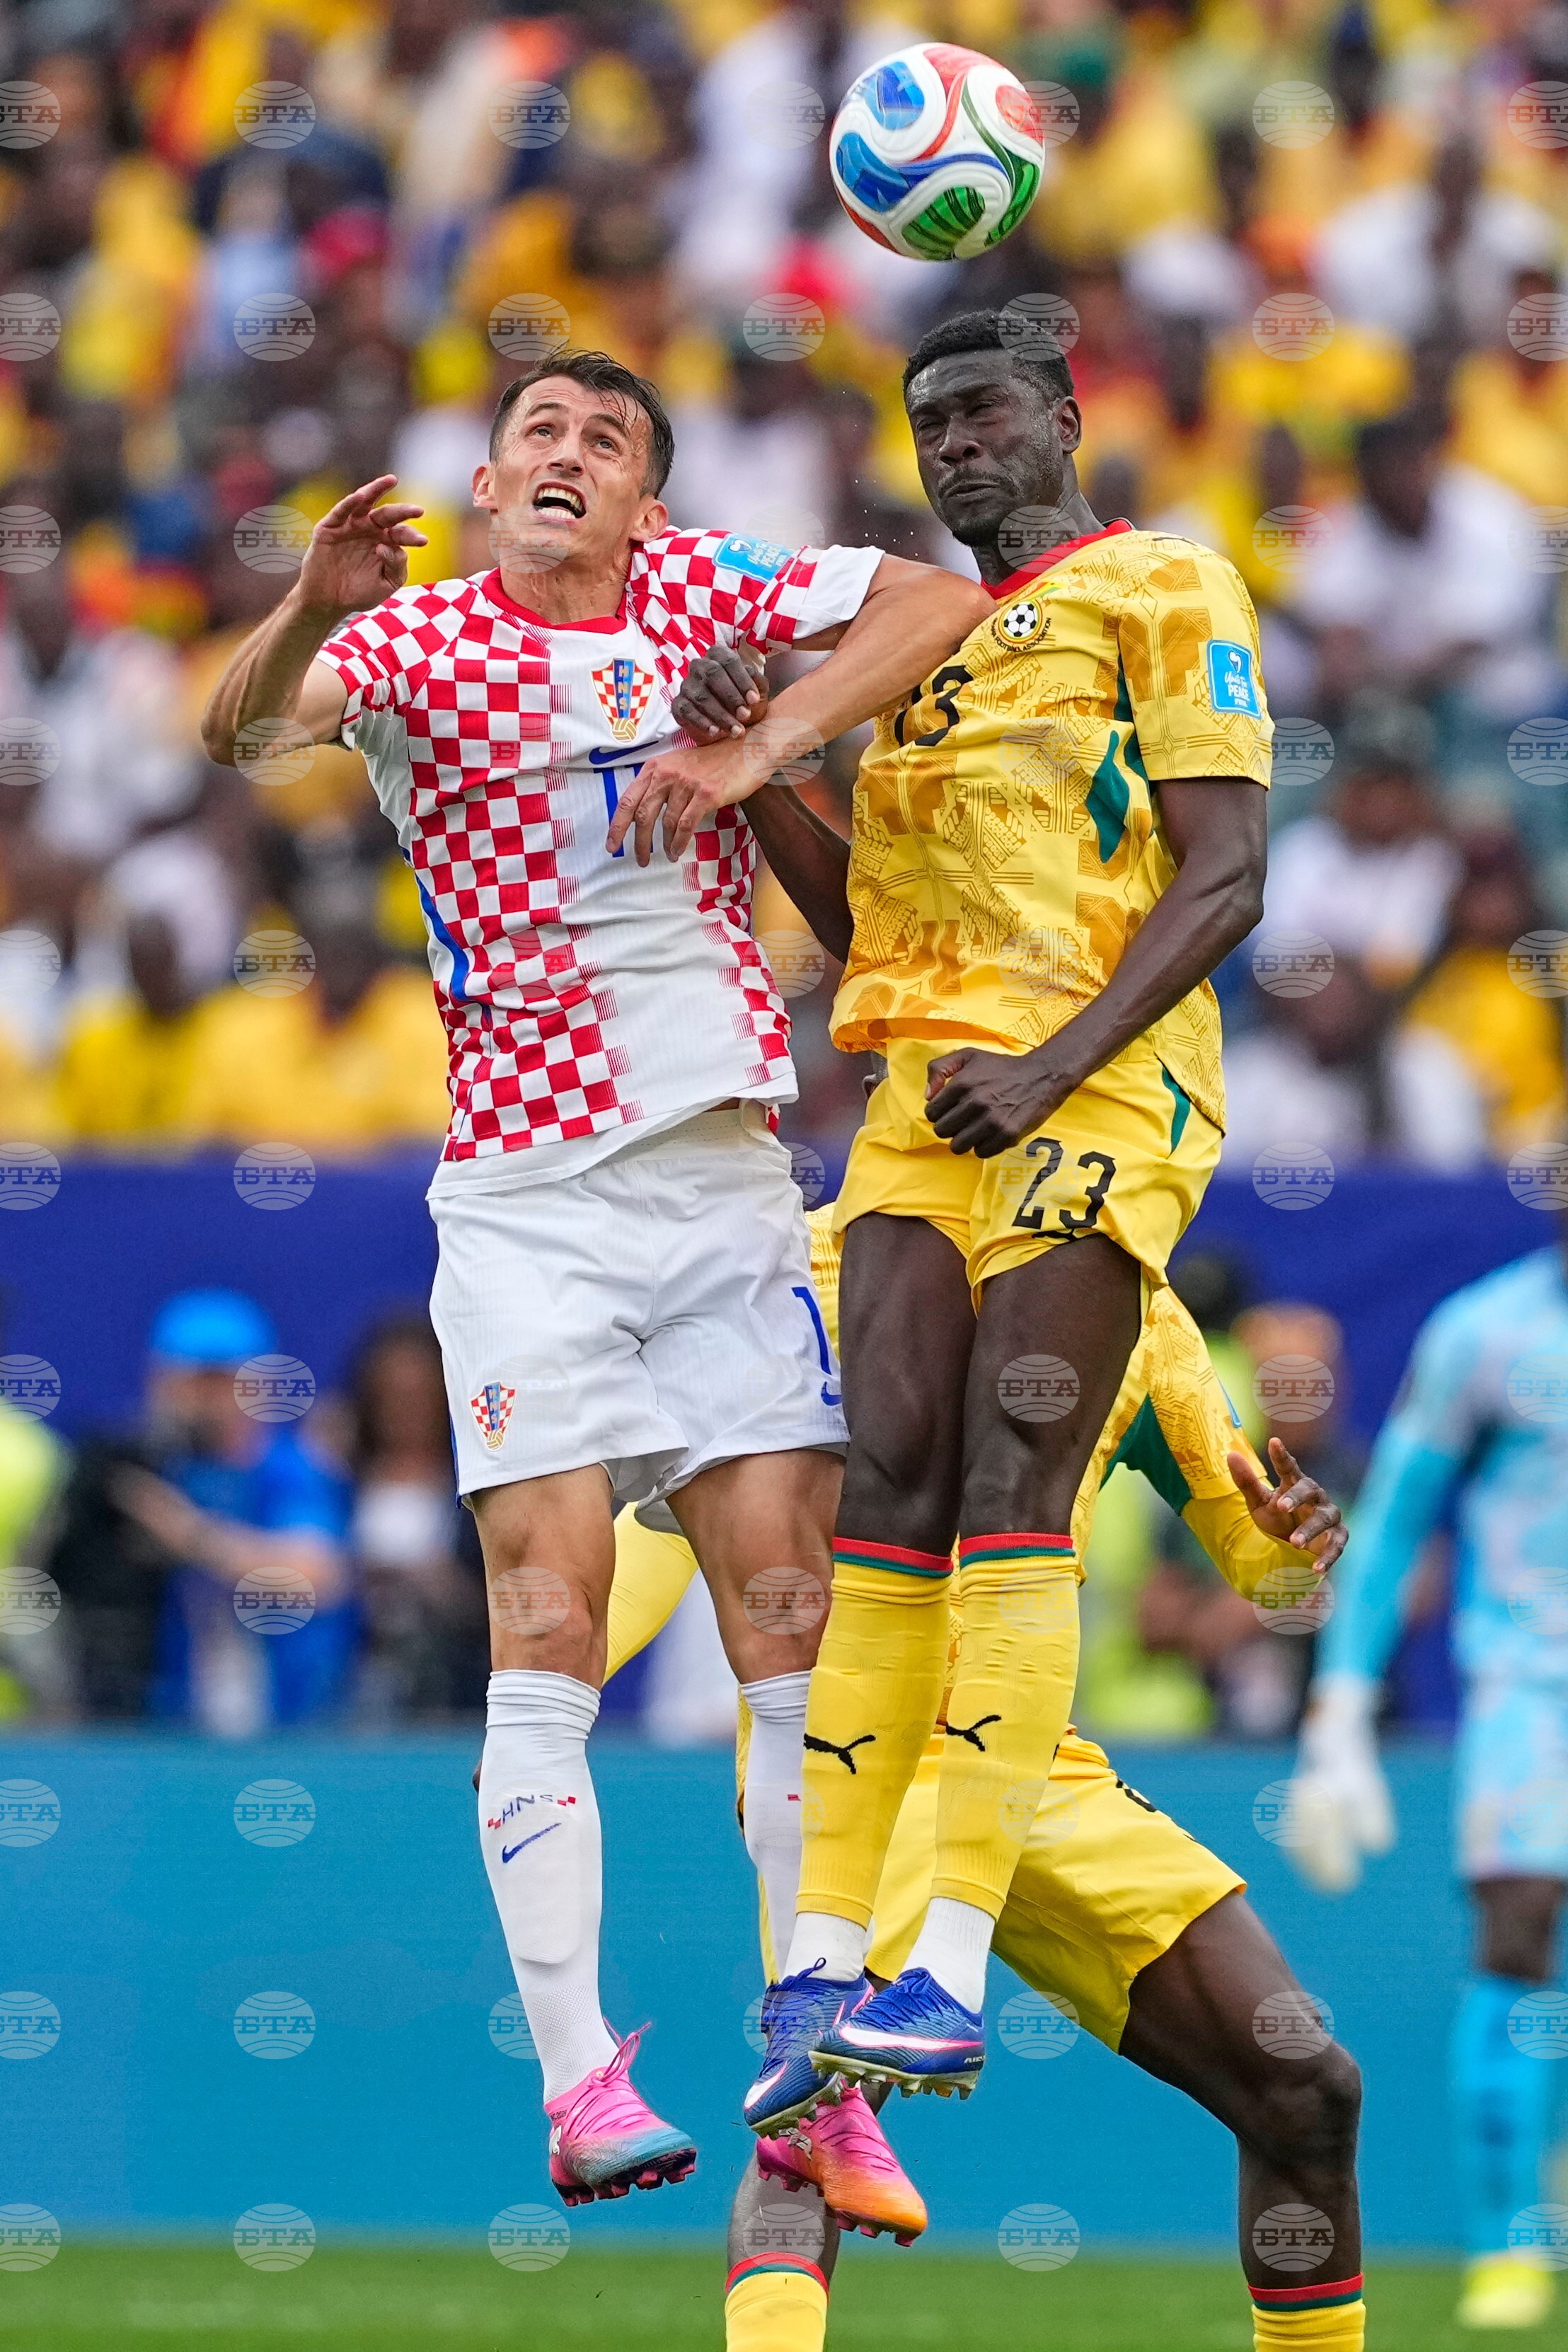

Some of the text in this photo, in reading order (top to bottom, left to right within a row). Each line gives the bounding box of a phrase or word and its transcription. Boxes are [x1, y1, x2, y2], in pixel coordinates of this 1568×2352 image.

[995, 635, 1022, 652] FOOTBALL
[1023, 617, 1052, 652] ASSOCIATION
[593, 763, 654, 858] 1
[1012, 1136, 1116, 1230] 23
[502, 1794, 553, 1824] HNS
